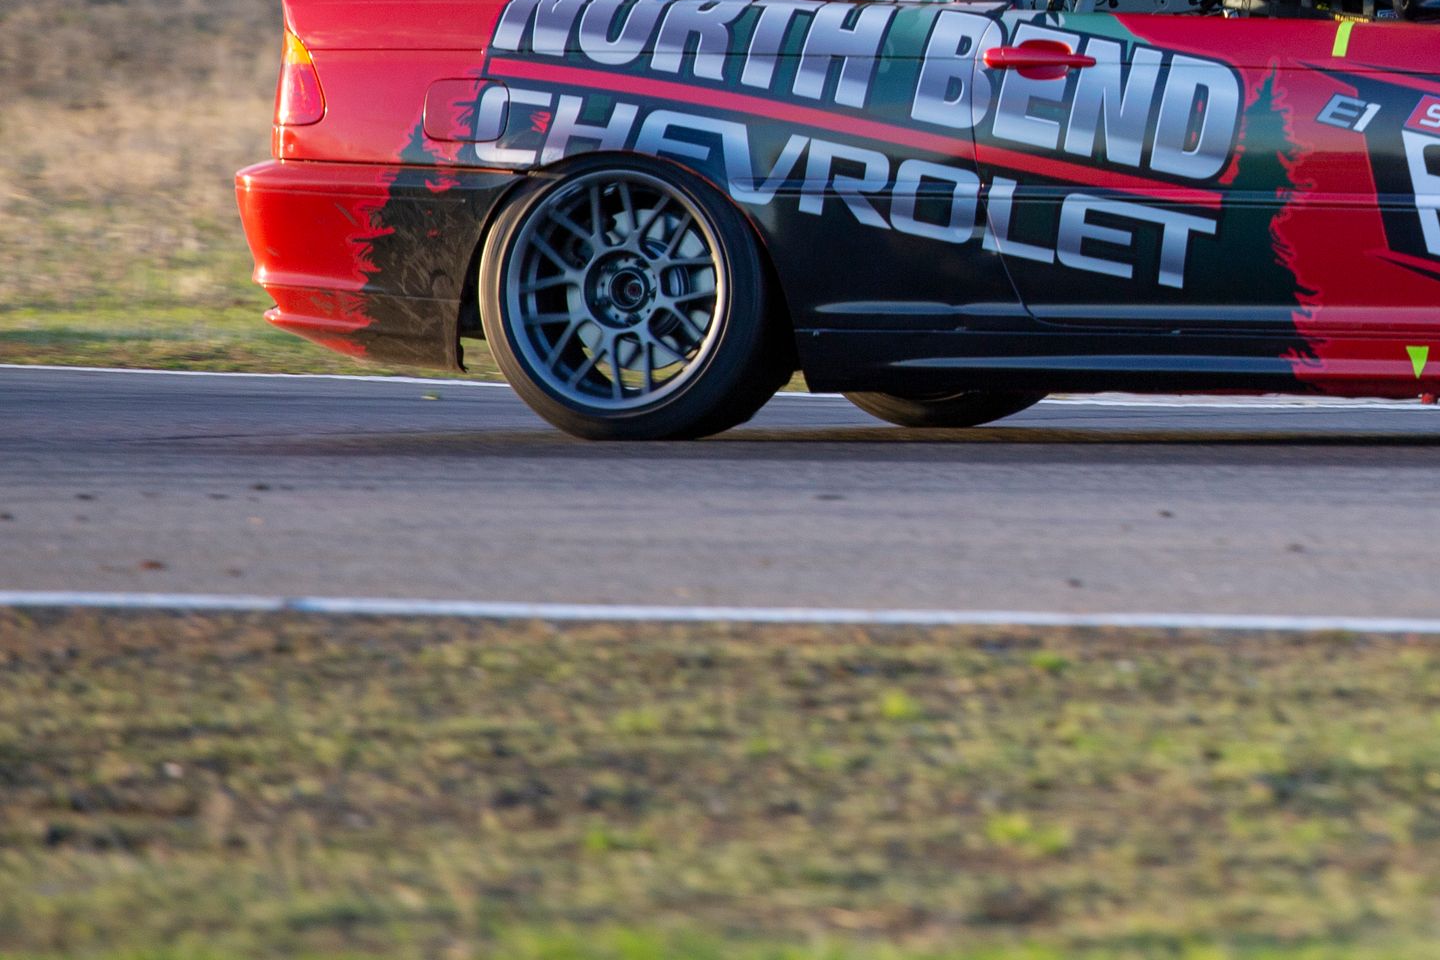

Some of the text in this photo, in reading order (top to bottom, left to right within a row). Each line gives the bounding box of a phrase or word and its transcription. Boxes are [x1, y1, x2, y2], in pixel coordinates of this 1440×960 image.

[910, 8, 1245, 181] BEND
[1316, 93, 1382, 133] E1
[474, 85, 1222, 289] CHEVROLET
